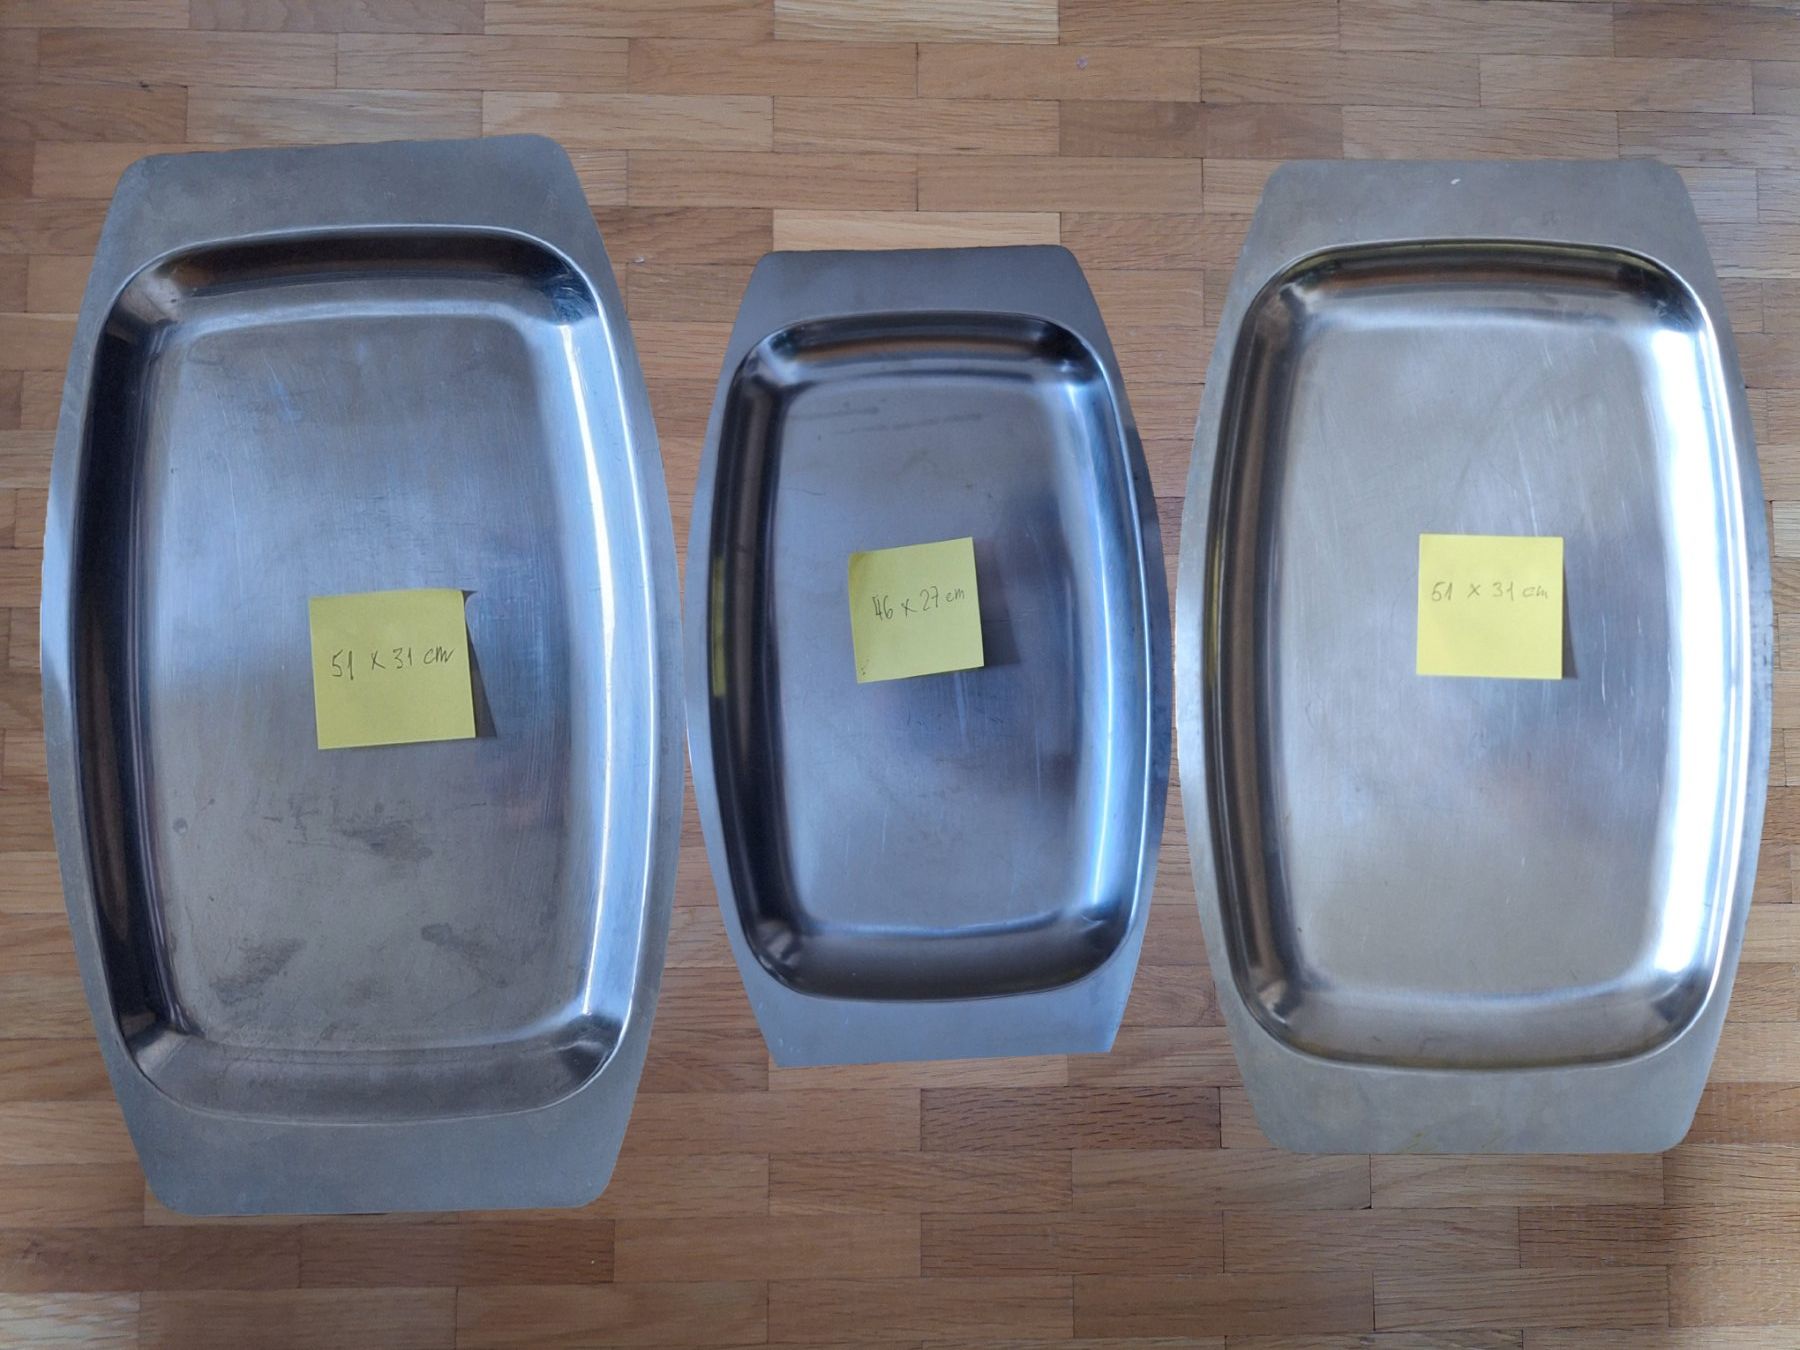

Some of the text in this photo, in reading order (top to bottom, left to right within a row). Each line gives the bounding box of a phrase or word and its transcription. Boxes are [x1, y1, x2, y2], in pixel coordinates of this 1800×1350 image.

[872, 595, 893, 621] 46
[920, 586, 938, 611] 27
[945, 588, 965, 602] cm
[1493, 581, 1514, 601] 31
[1522, 585, 1548, 599] cm
[331, 649, 354, 680] 51
[393, 648, 412, 669] 31
[423, 646, 455, 665] cm
